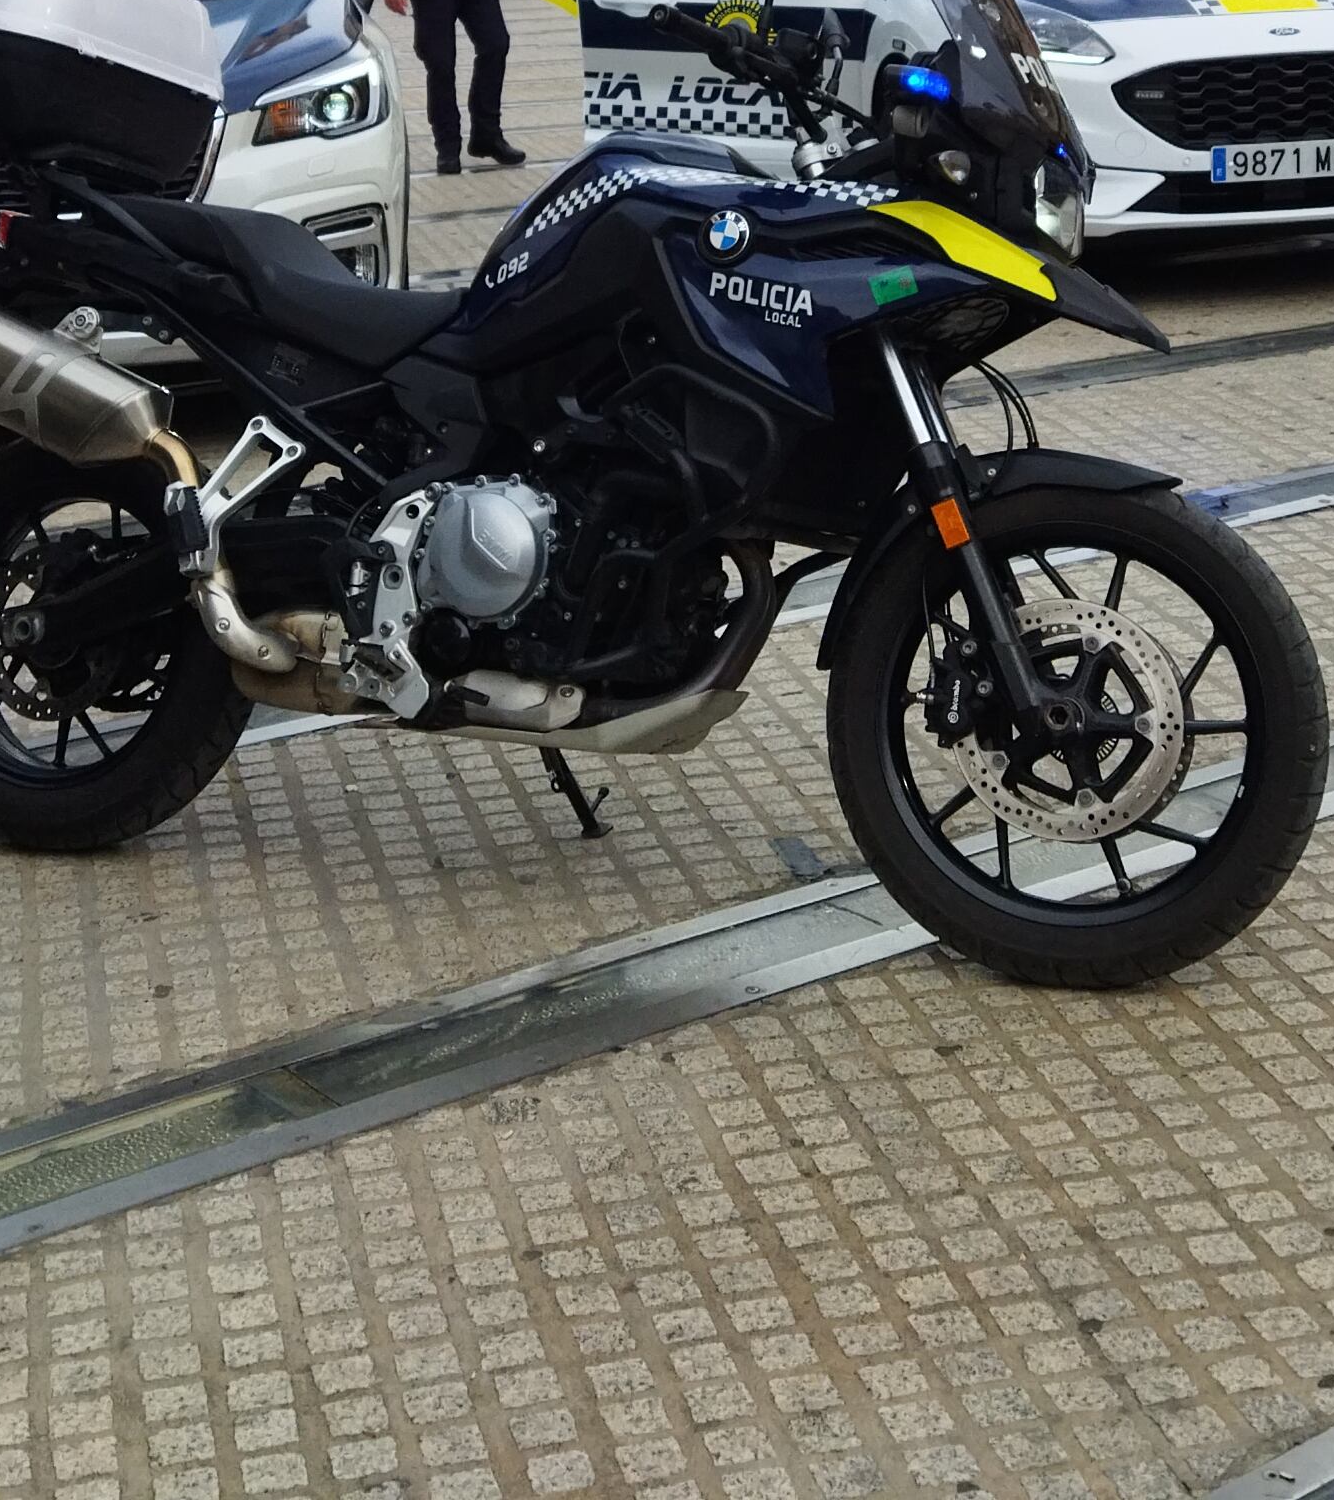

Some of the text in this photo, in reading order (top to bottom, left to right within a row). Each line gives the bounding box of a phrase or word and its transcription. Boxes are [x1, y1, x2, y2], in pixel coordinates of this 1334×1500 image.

[668, 75, 787, 108] LOCA
[1233, 146, 1302, 177] 9871
[496, 252, 530, 284] 092
[709, 272, 814, 317] POLICIA
[764, 310, 803, 329] LOCAL
